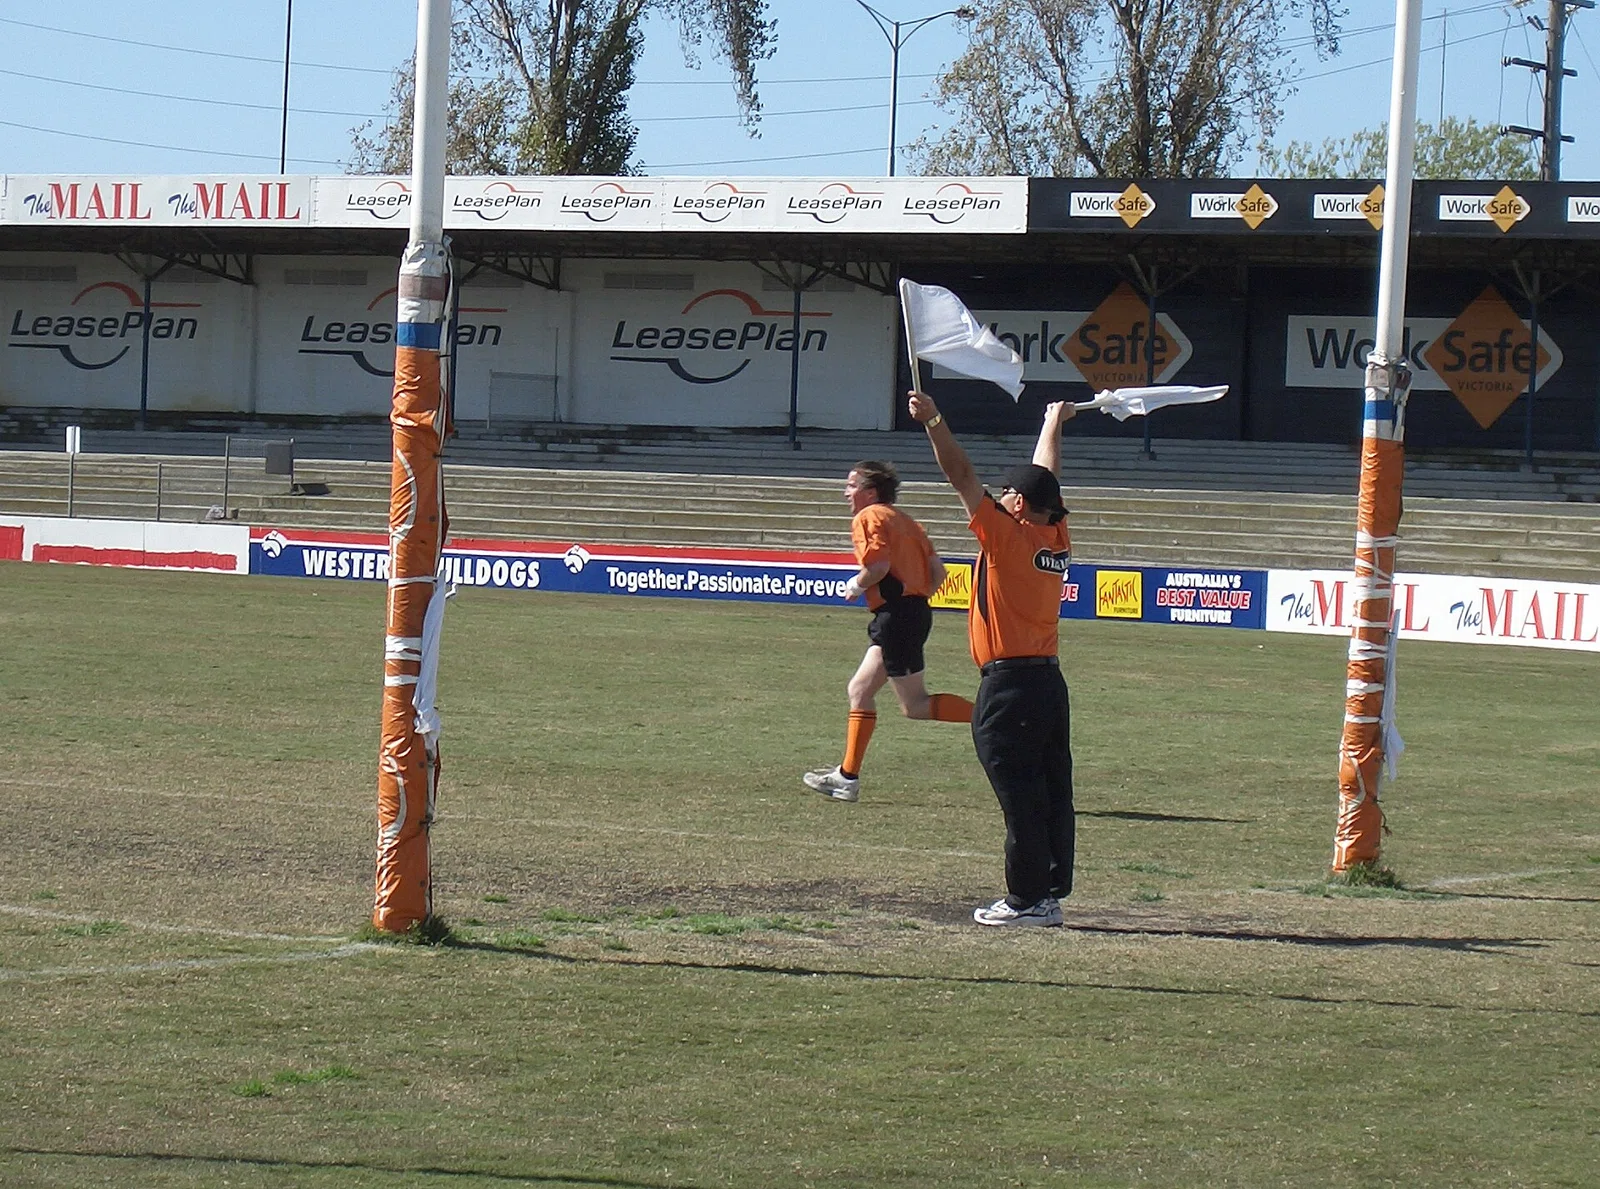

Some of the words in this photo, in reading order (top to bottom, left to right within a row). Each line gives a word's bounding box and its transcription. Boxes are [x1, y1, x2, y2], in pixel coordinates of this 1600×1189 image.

[24, 193, 52, 216] The
[47, 182, 152, 220] MAIL
[168, 193, 196, 217] The
[193, 182, 300, 220] MAIL
[347, 193, 412, 206] LeasePl
[453, 195, 541, 208] LeasePlan
[561, 195, 651, 209] LeasePlan
[673, 195, 765, 209] LeasePlan
[787, 196, 882, 210] LeasePlan
[904, 196, 1001, 210] LeasePlan
[1077, 197, 1113, 211] Work
[1118, 197, 1148, 211] Safe
[1199, 197, 1235, 212] Work
[1240, 197, 1270, 212] Safe
[1321, 198, 1360, 213] Work
[1364, 198, 1384, 213] Saf
[1447, 199, 1486, 214] Work
[1490, 200, 1522, 215] Safe
[1575, 201, 1600, 216] Wo
[301, 315, 502, 346] Leasan
[612, 320, 828, 352] LeasePlan
[990, 321, 1066, 363] ork
[1078, 321, 1167, 365] Safe
[1306, 326, 1428, 371] Wok
[1443, 328, 1535, 374] Safe
[1457, 379, 1514, 392] VICTORIA
[302, 549, 390, 580] WESTER
[437, 556, 540, 588] ULLDOGS
[1166, 573, 1241, 588] AUSTRALIA'S
[1157, 588, 1196, 607] BEST
[1200, 589, 1251, 609] VALUE
[1281, 592, 1313, 621] The
[1170, 608, 1232, 623] FURNITURE
[1450, 600, 1482, 629] The
[1476, 587, 1599, 643] MAIL
